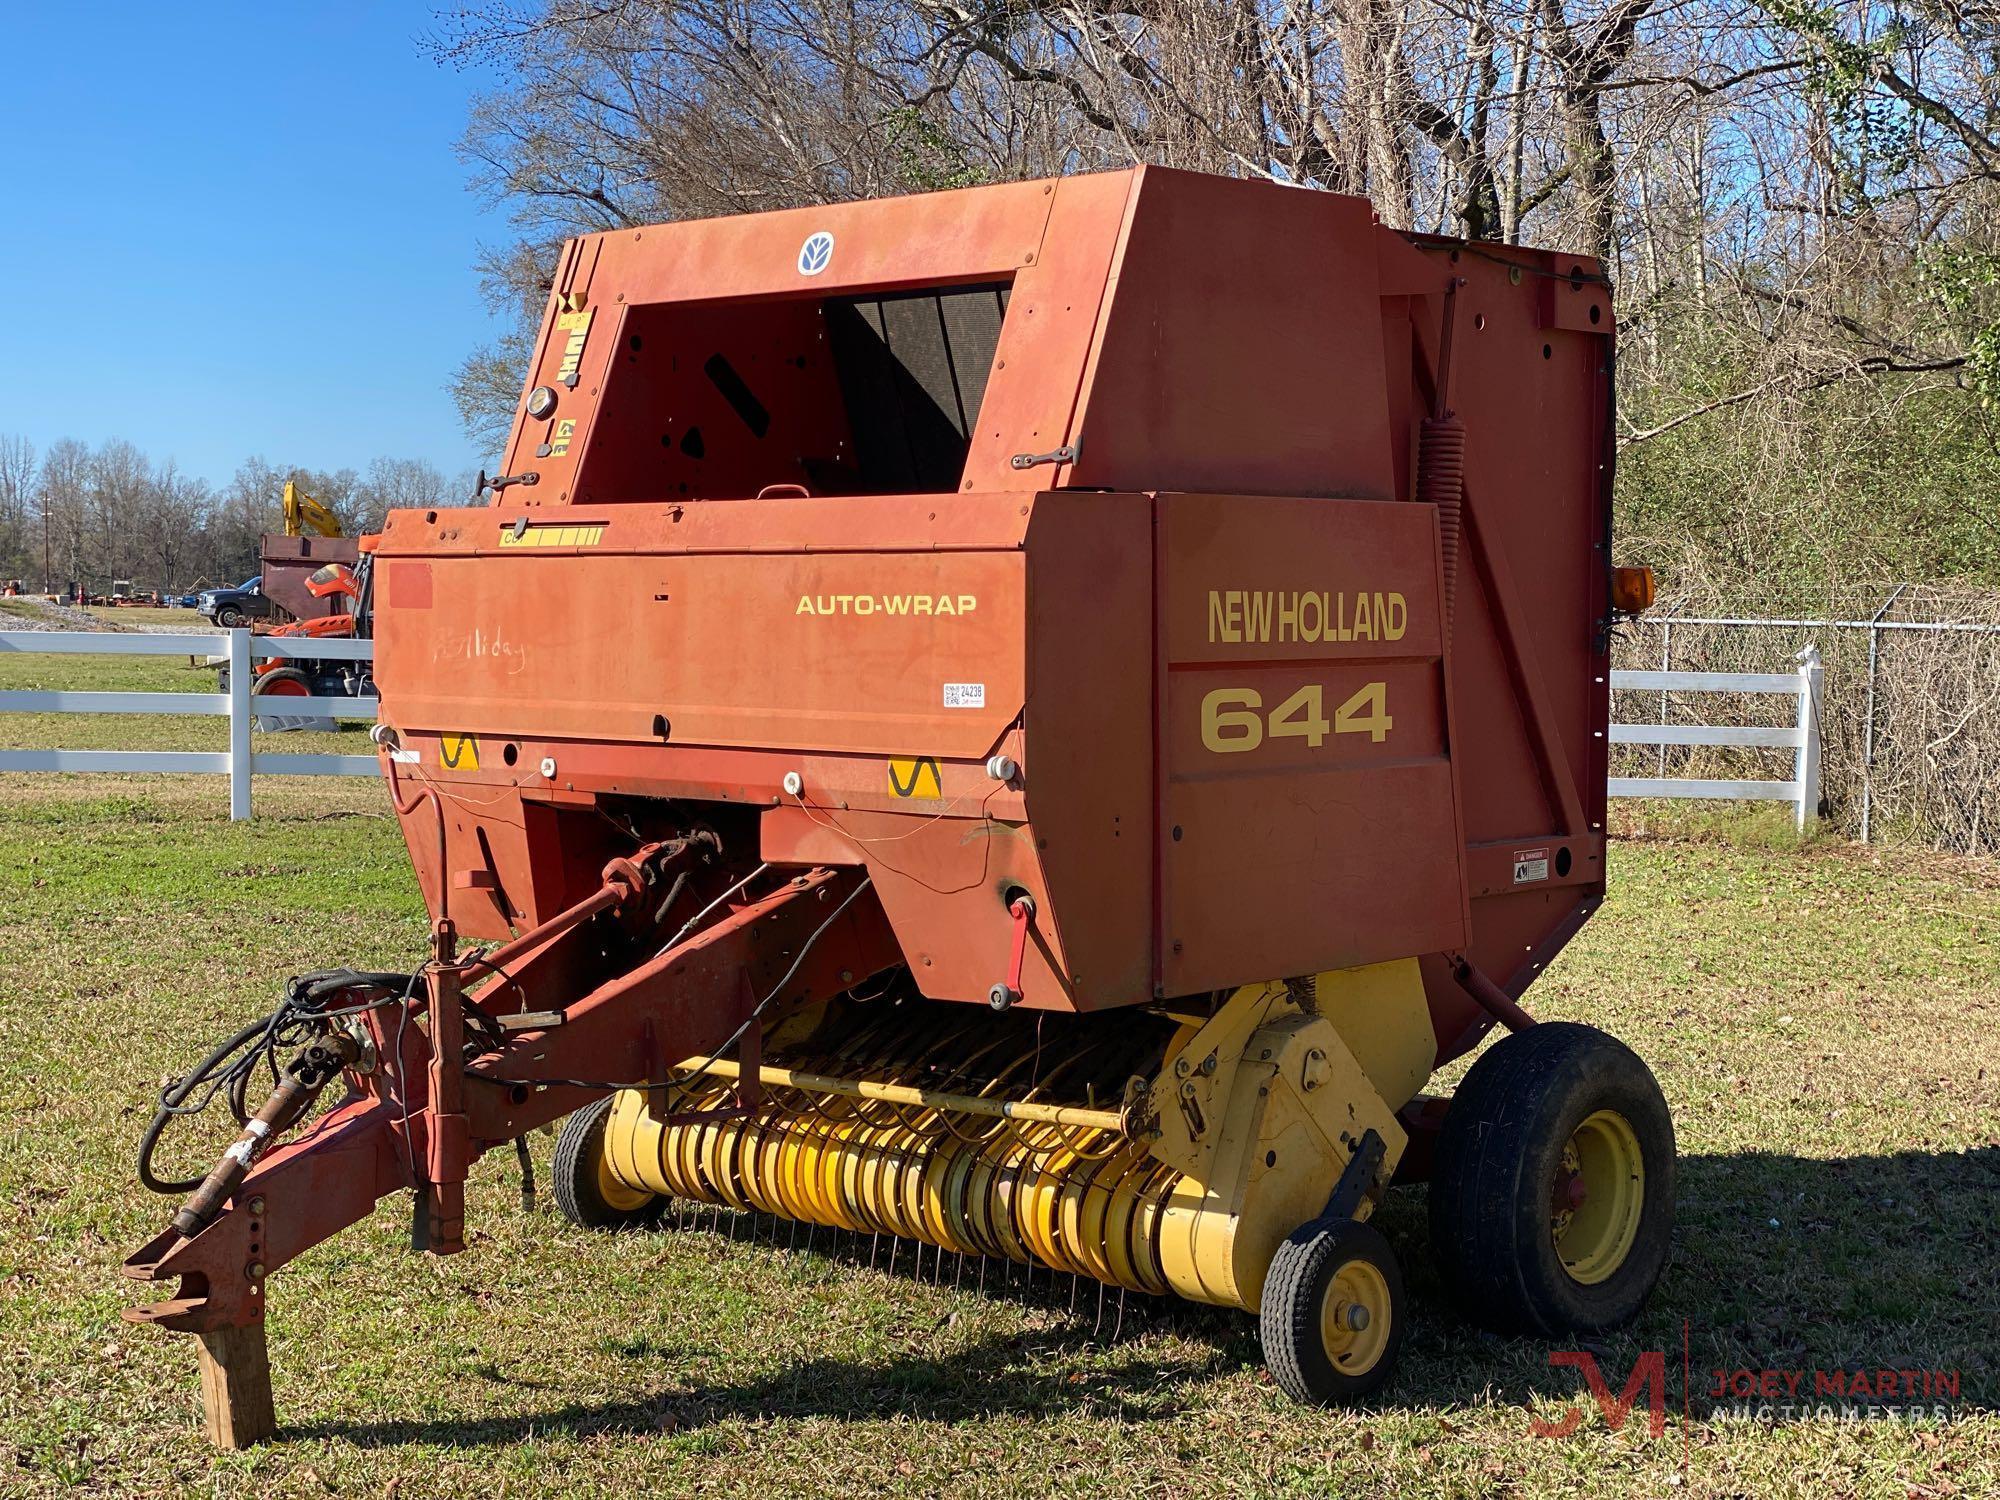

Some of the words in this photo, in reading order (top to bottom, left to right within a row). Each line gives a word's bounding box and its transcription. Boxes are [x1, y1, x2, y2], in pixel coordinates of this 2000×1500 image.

[795, 595, 977, 616] AUTO-WRAP
[1208, 590, 1274, 643] NEW
[1278, 591, 1408, 643] HOLLAND
[961, 685, 982, 698] 24238
[1201, 682, 1393, 753] 644
